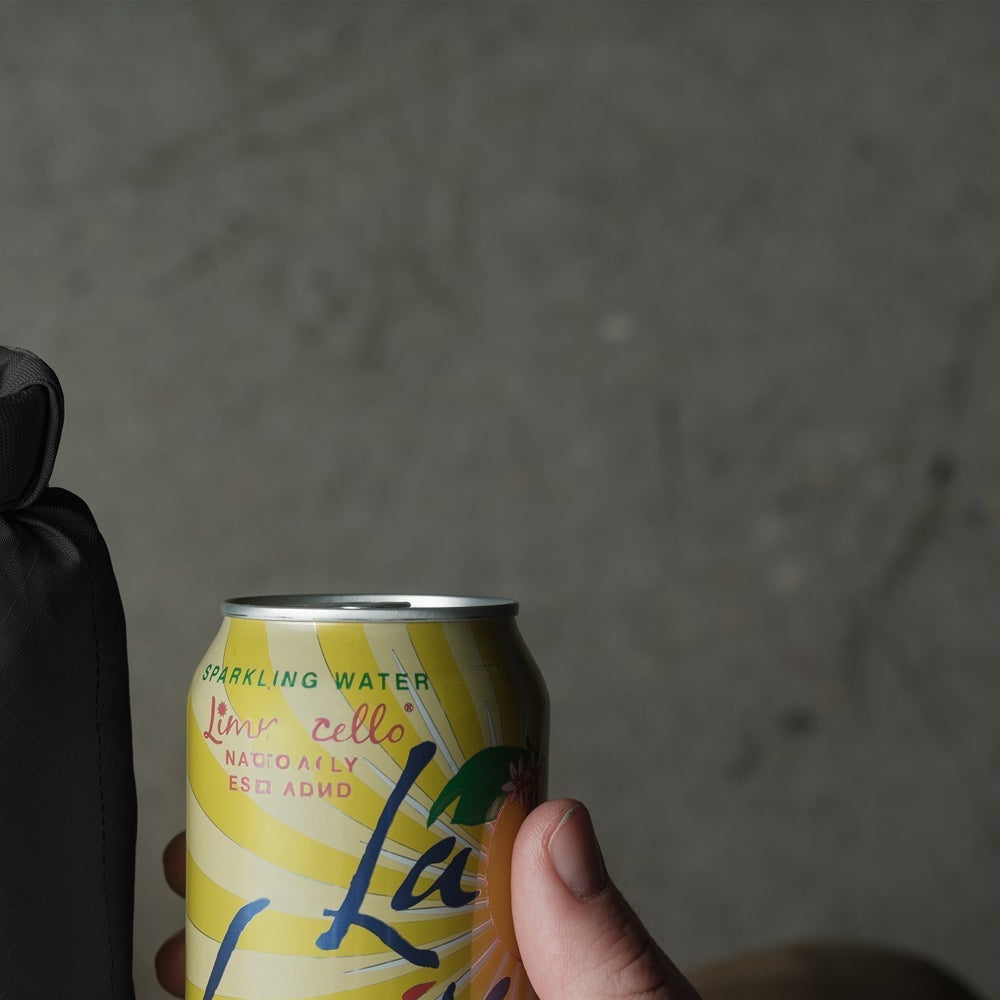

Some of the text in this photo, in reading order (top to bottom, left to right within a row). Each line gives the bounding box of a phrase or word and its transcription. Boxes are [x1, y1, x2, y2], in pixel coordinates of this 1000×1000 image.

[202, 663, 430, 691] SPARKLING WATER
[316, 740, 481, 968] La
